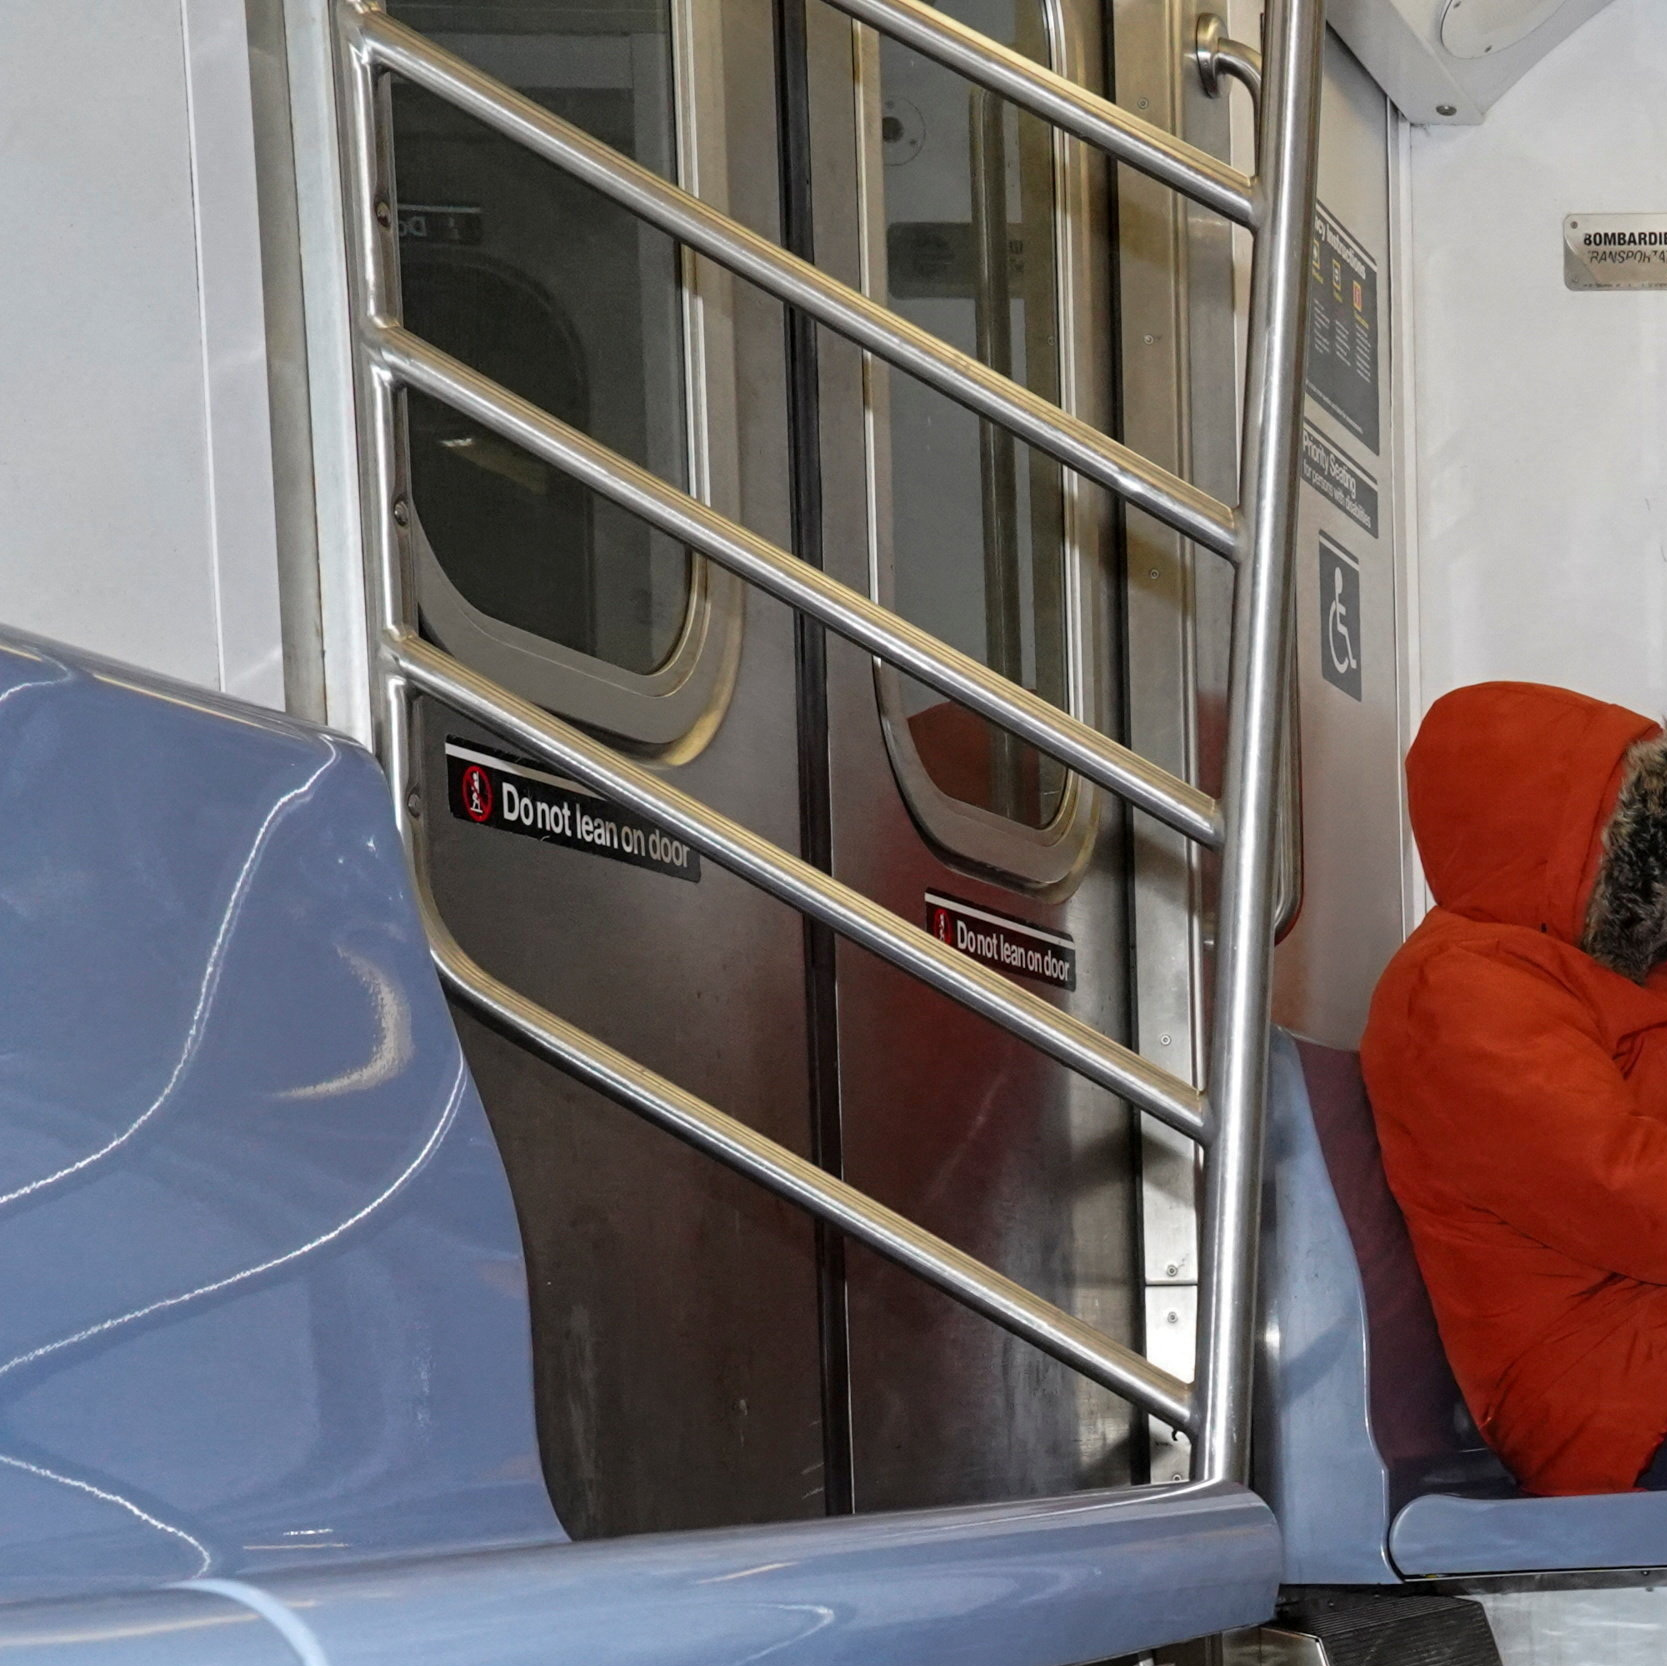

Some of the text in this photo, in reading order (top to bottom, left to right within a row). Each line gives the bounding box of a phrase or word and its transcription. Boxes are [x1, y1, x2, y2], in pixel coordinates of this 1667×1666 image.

[1303, 430, 1357, 500] Priority Seating
[502, 782, 691, 868] Do not lean on door
[957, 920, 1070, 982] Do not lean on door
